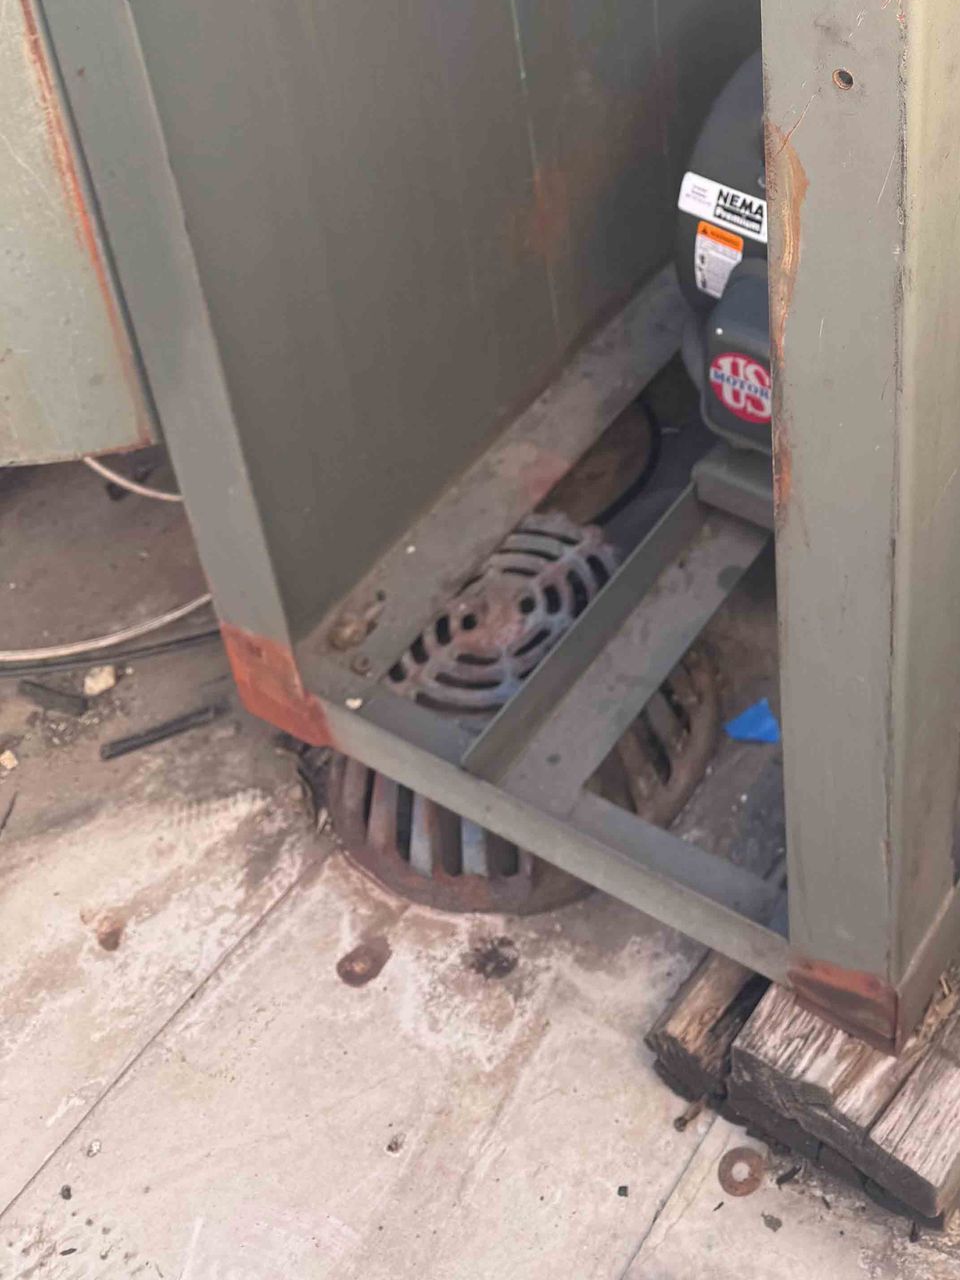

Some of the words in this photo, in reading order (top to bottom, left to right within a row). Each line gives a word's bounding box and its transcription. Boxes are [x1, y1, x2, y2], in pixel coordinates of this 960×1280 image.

[717, 188, 764, 218] NEMA
[713, 370, 769, 400] MOTOR
[715, 356, 772, 417] US
